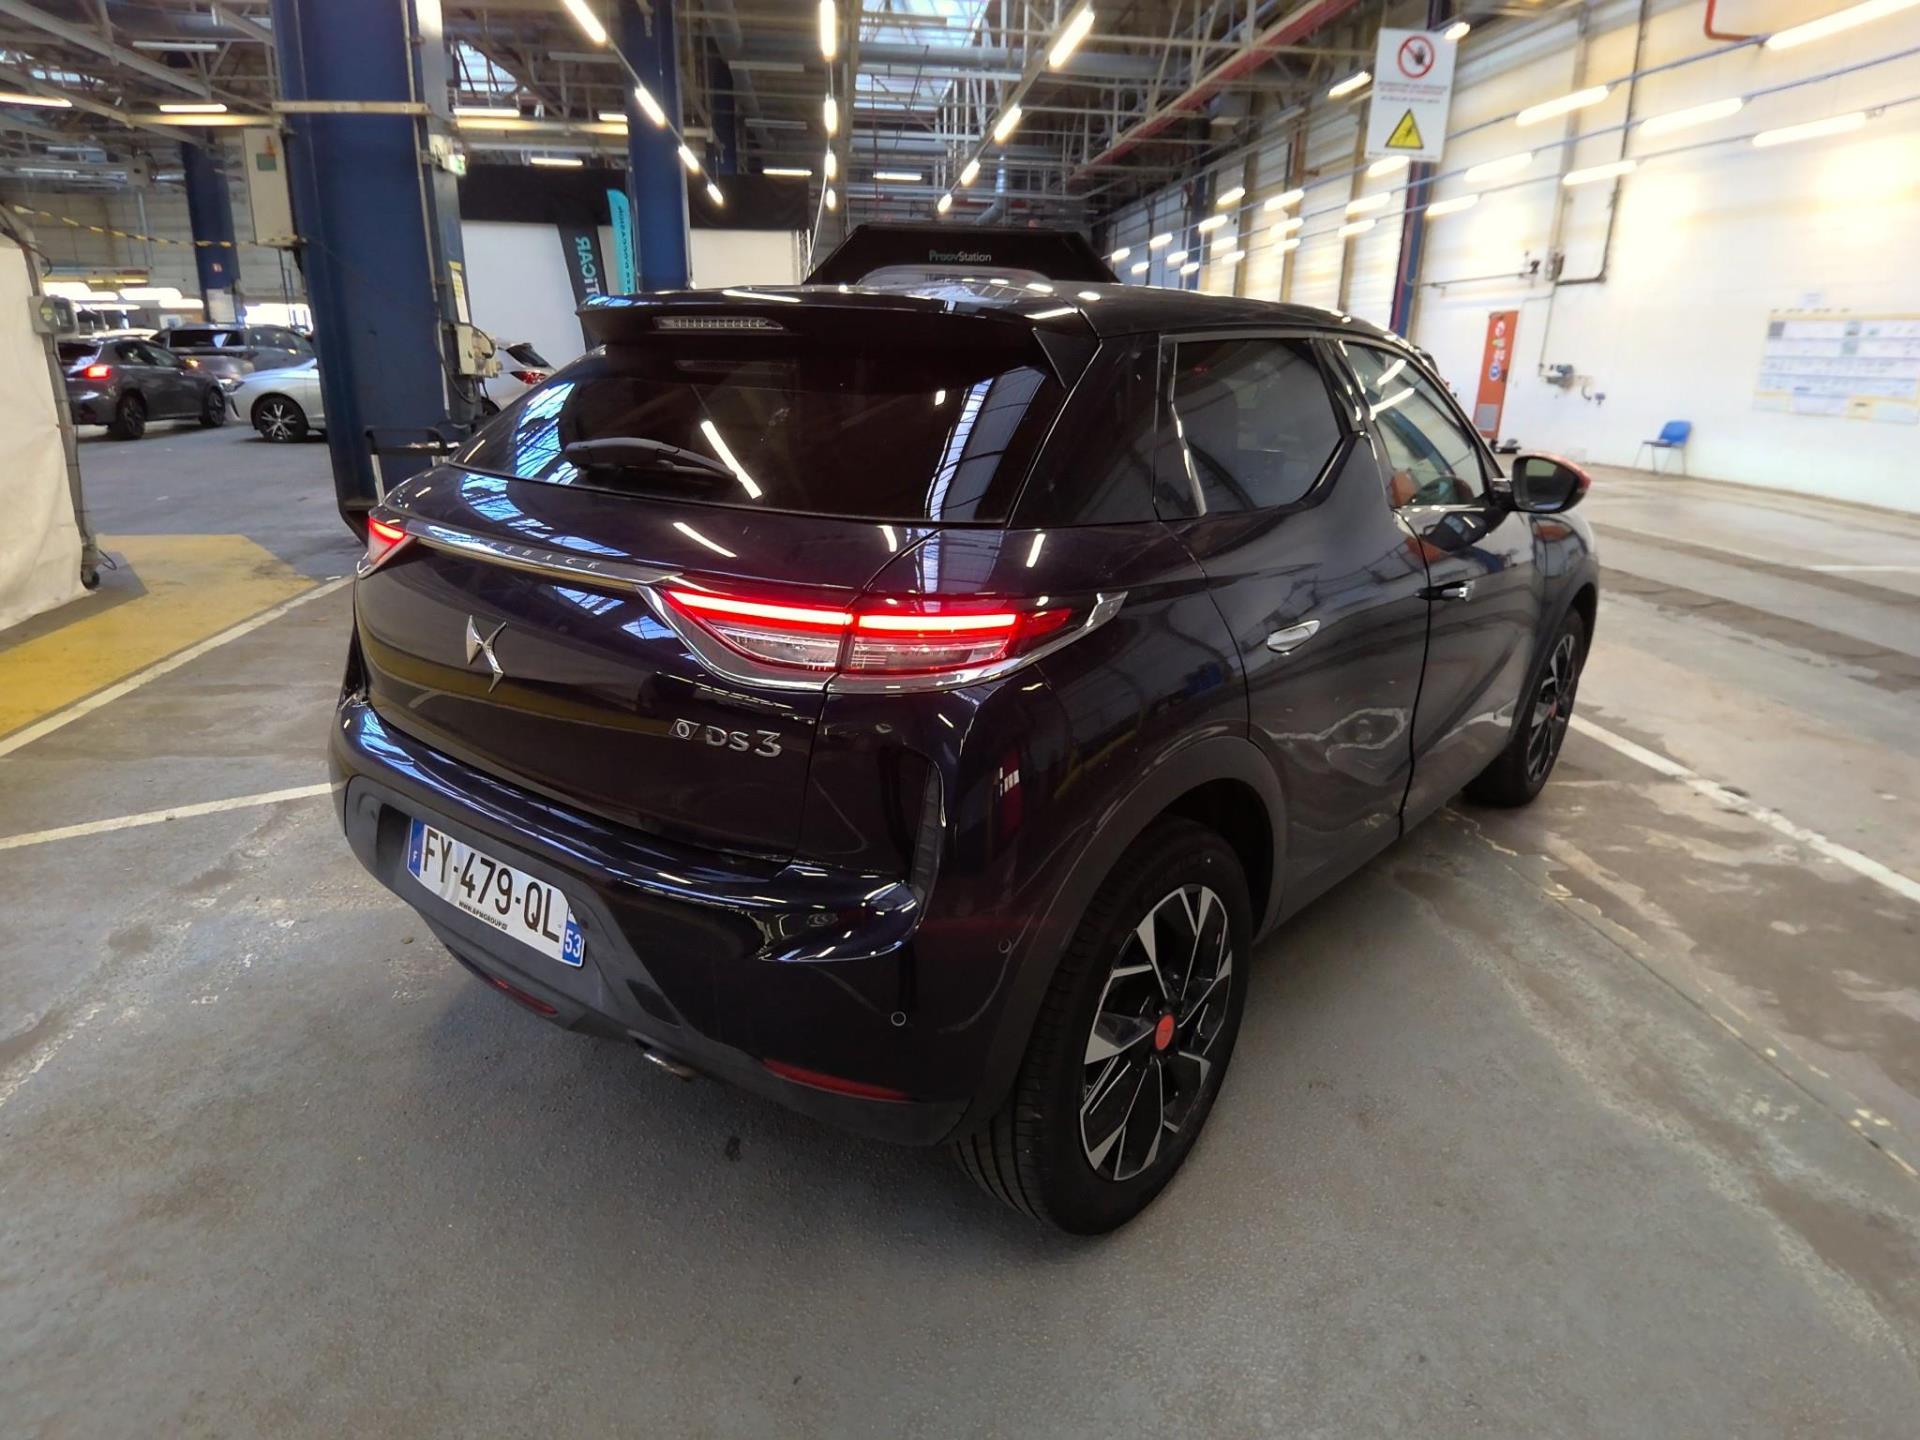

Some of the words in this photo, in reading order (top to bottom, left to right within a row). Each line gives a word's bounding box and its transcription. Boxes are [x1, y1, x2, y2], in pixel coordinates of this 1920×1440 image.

[706, 725, 750, 752] DS
[754, 729, 782, 758] 3
[423, 828, 560, 944] FY-479-QL
[564, 928, 582, 958] 53
